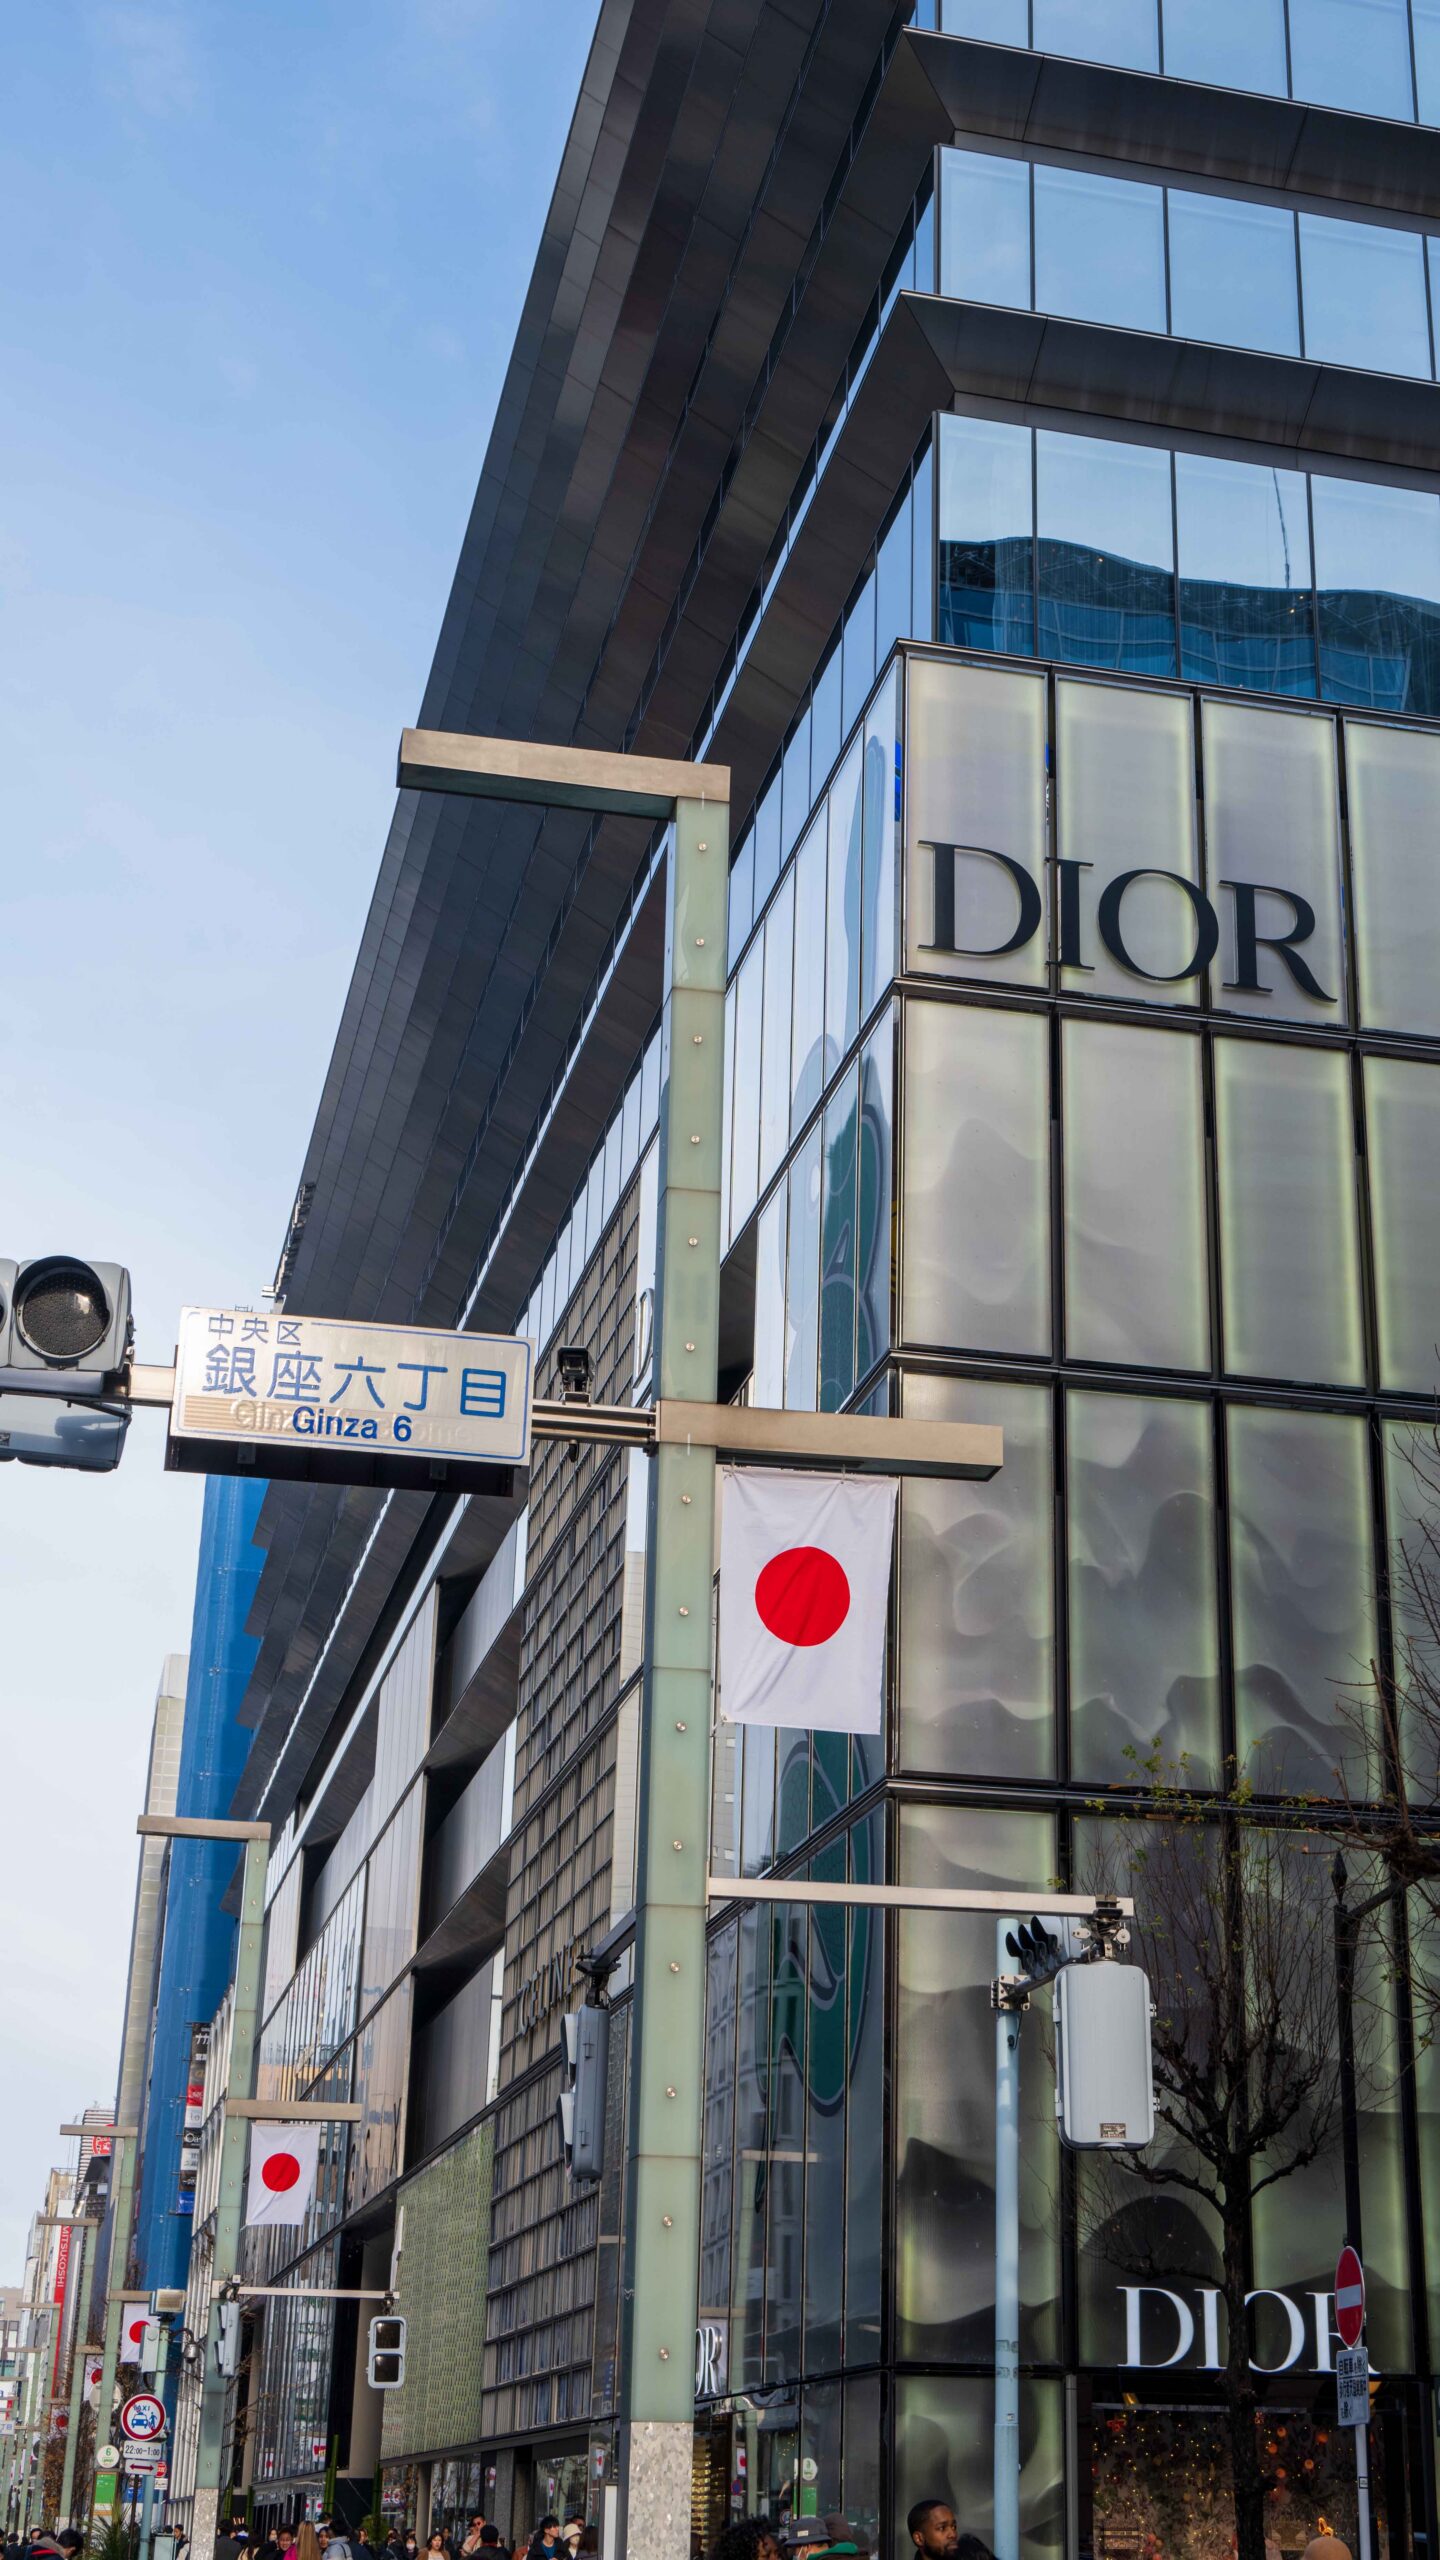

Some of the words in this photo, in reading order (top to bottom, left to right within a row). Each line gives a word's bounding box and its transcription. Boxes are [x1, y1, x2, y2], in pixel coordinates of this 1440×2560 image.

[917, 839, 1338, 1003] DIOR
[207, 1313, 303, 1346] 中央区
[201, 1343, 507, 1419] 銀座六丁目
[292, 1405, 379, 1441] Ginza
[393, 1415, 413, 1442] 6
[518, 1936, 576, 2036] CELINE
[57, 2225, 71, 2287] MITSUKOSHI
